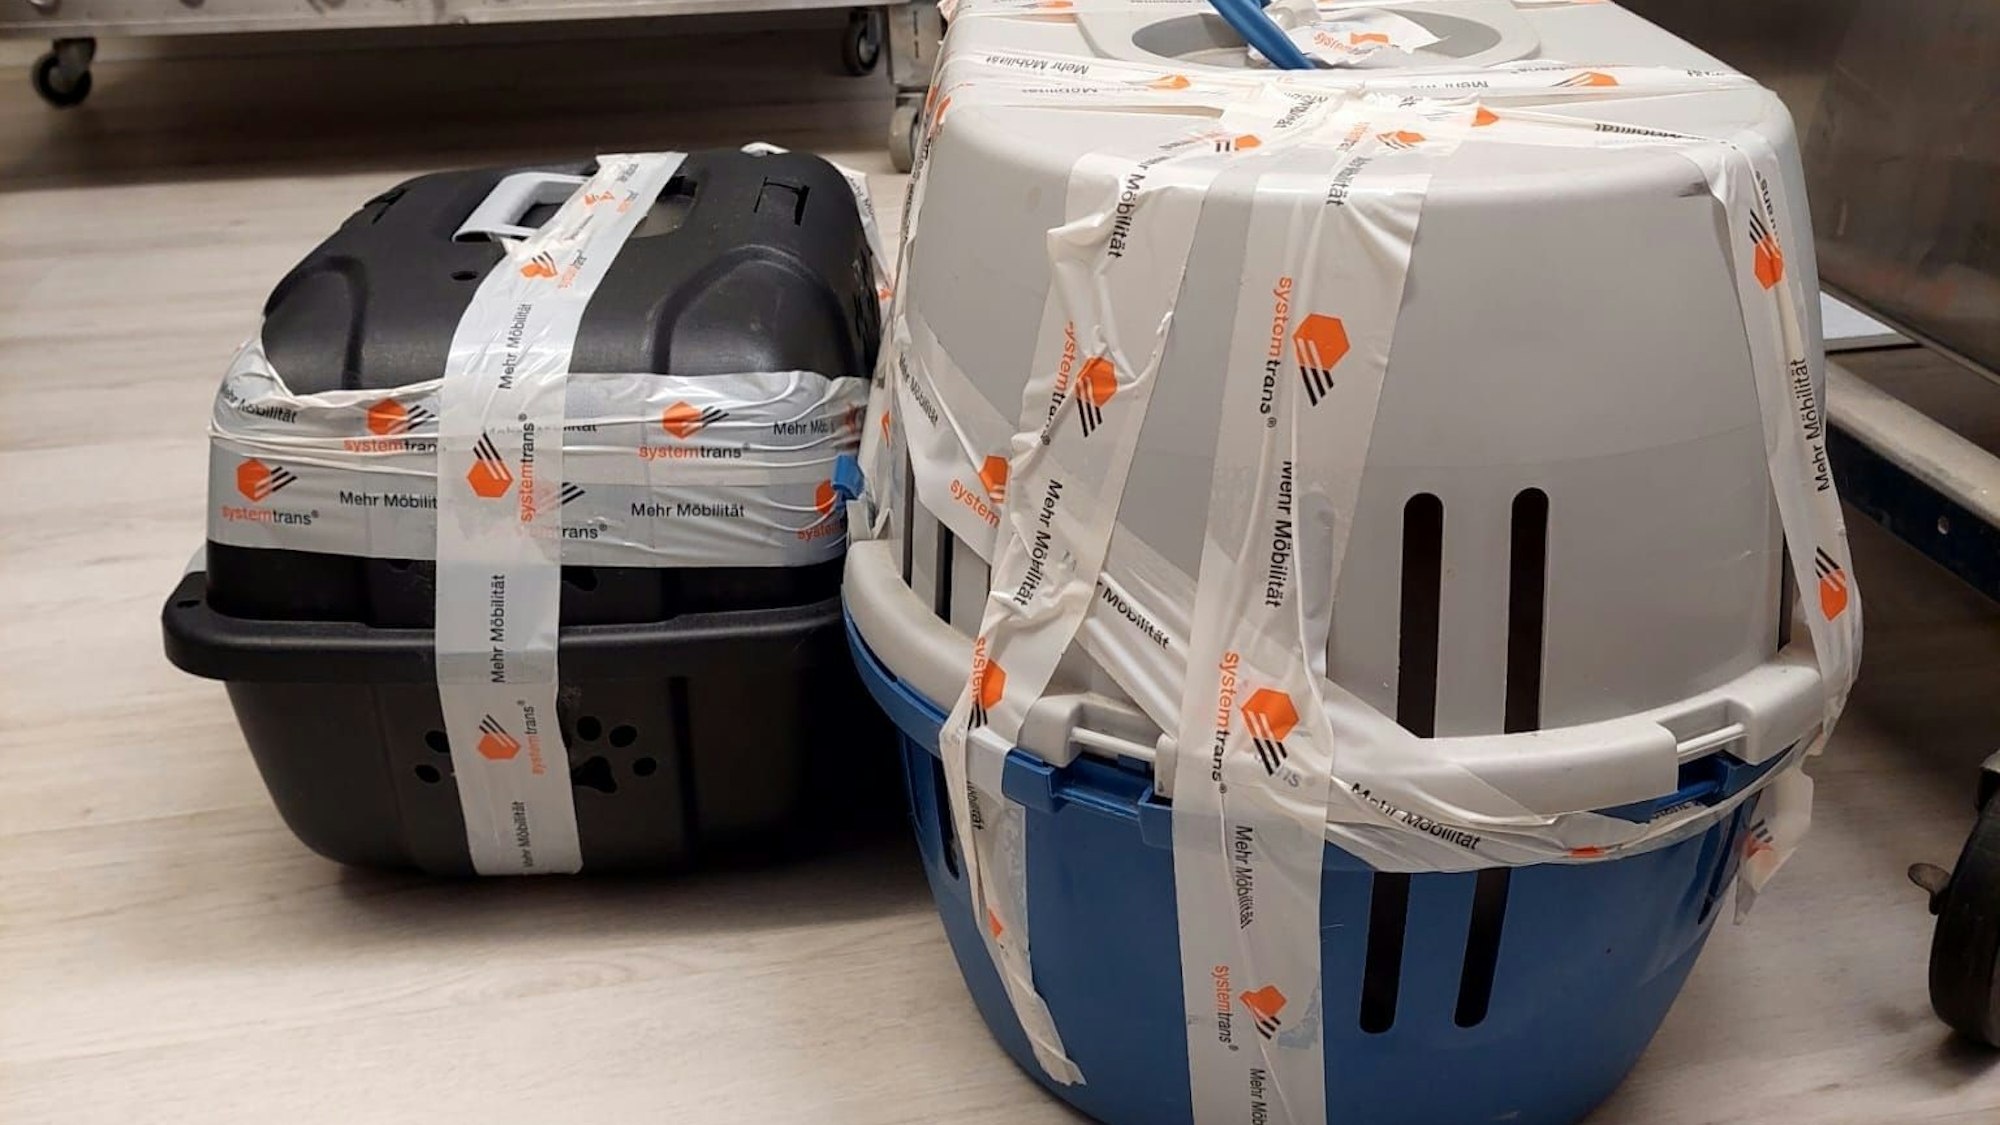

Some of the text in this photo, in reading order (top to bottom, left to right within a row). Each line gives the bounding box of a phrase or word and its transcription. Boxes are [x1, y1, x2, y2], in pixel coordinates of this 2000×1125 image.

[498, 350, 517, 390] Mehr
[344, 438, 438, 454] systemtran
[773, 421, 808, 436] Mehr
[1811, 444, 1830, 492] Mehr
[339, 490, 438, 509] Mehr Möbilit
[630, 502, 746, 519] Mehr Möbilität
[950, 478, 1001, 528] system
[1040, 478, 1064, 529] Mehr
[1264, 519, 1292, 608] Möbilität
[489, 574, 506, 684] Mehr Möbilität
[1234, 825, 1253, 864] Mehr
[1249, 1068, 1266, 1099] Mehr
